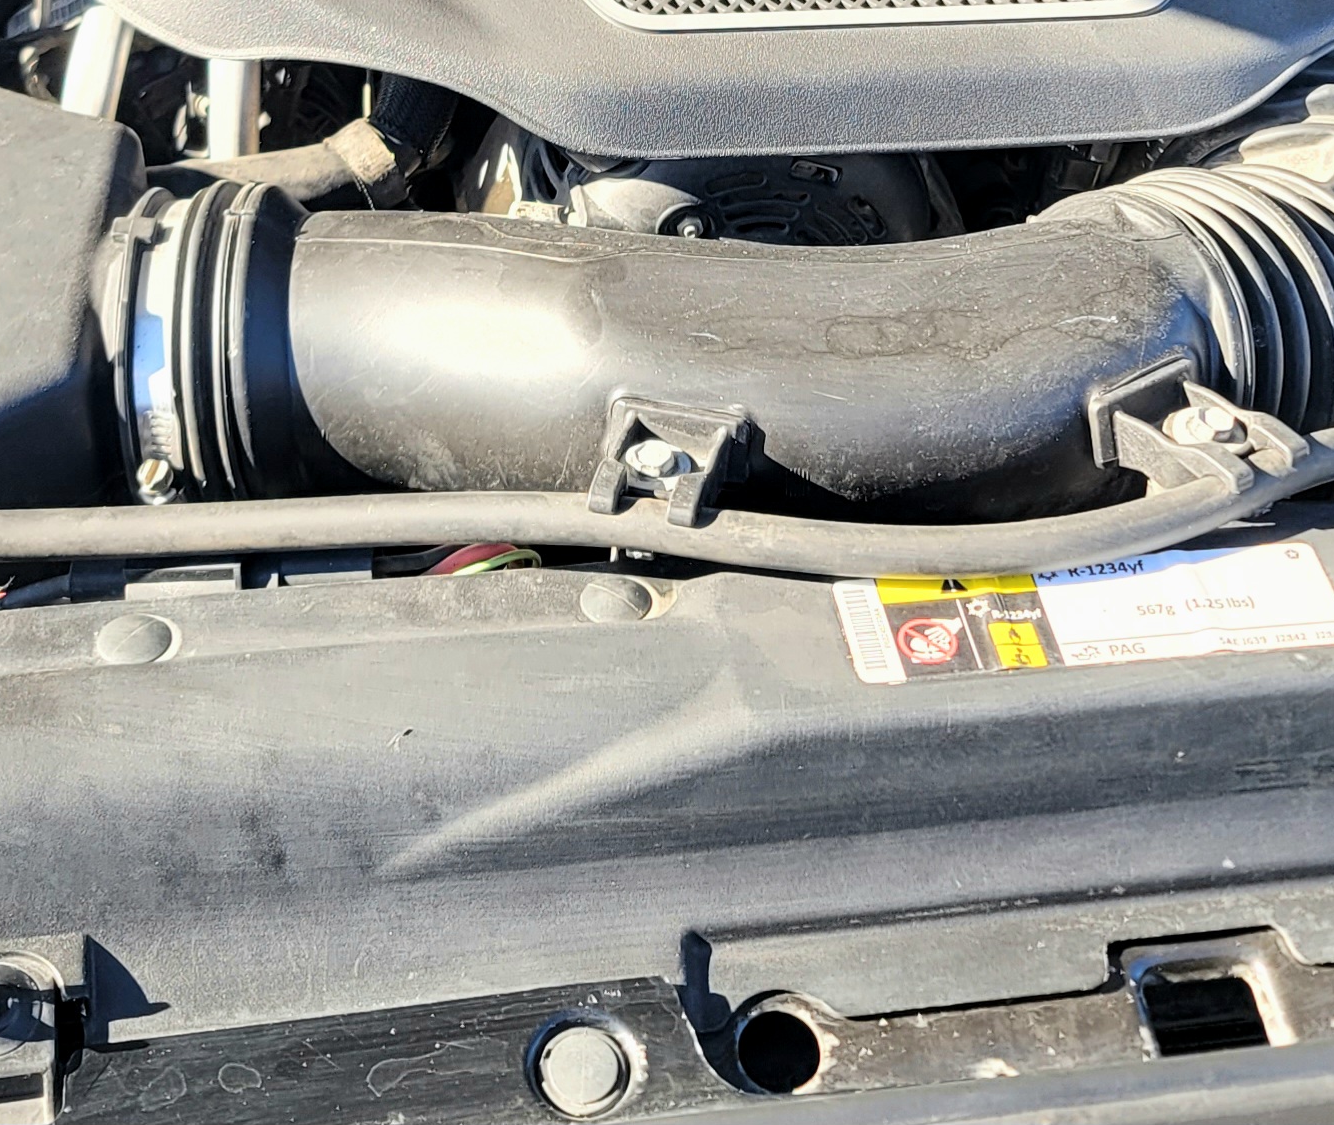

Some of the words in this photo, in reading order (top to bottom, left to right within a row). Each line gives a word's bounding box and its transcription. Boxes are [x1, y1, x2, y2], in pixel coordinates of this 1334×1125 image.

[1068, 559, 1145, 578] R-1234yf
[1137, 604, 1176, 616] 567g
[1227, 595, 1255, 609] lbs)
[1109, 643, 1146, 656] PAG
